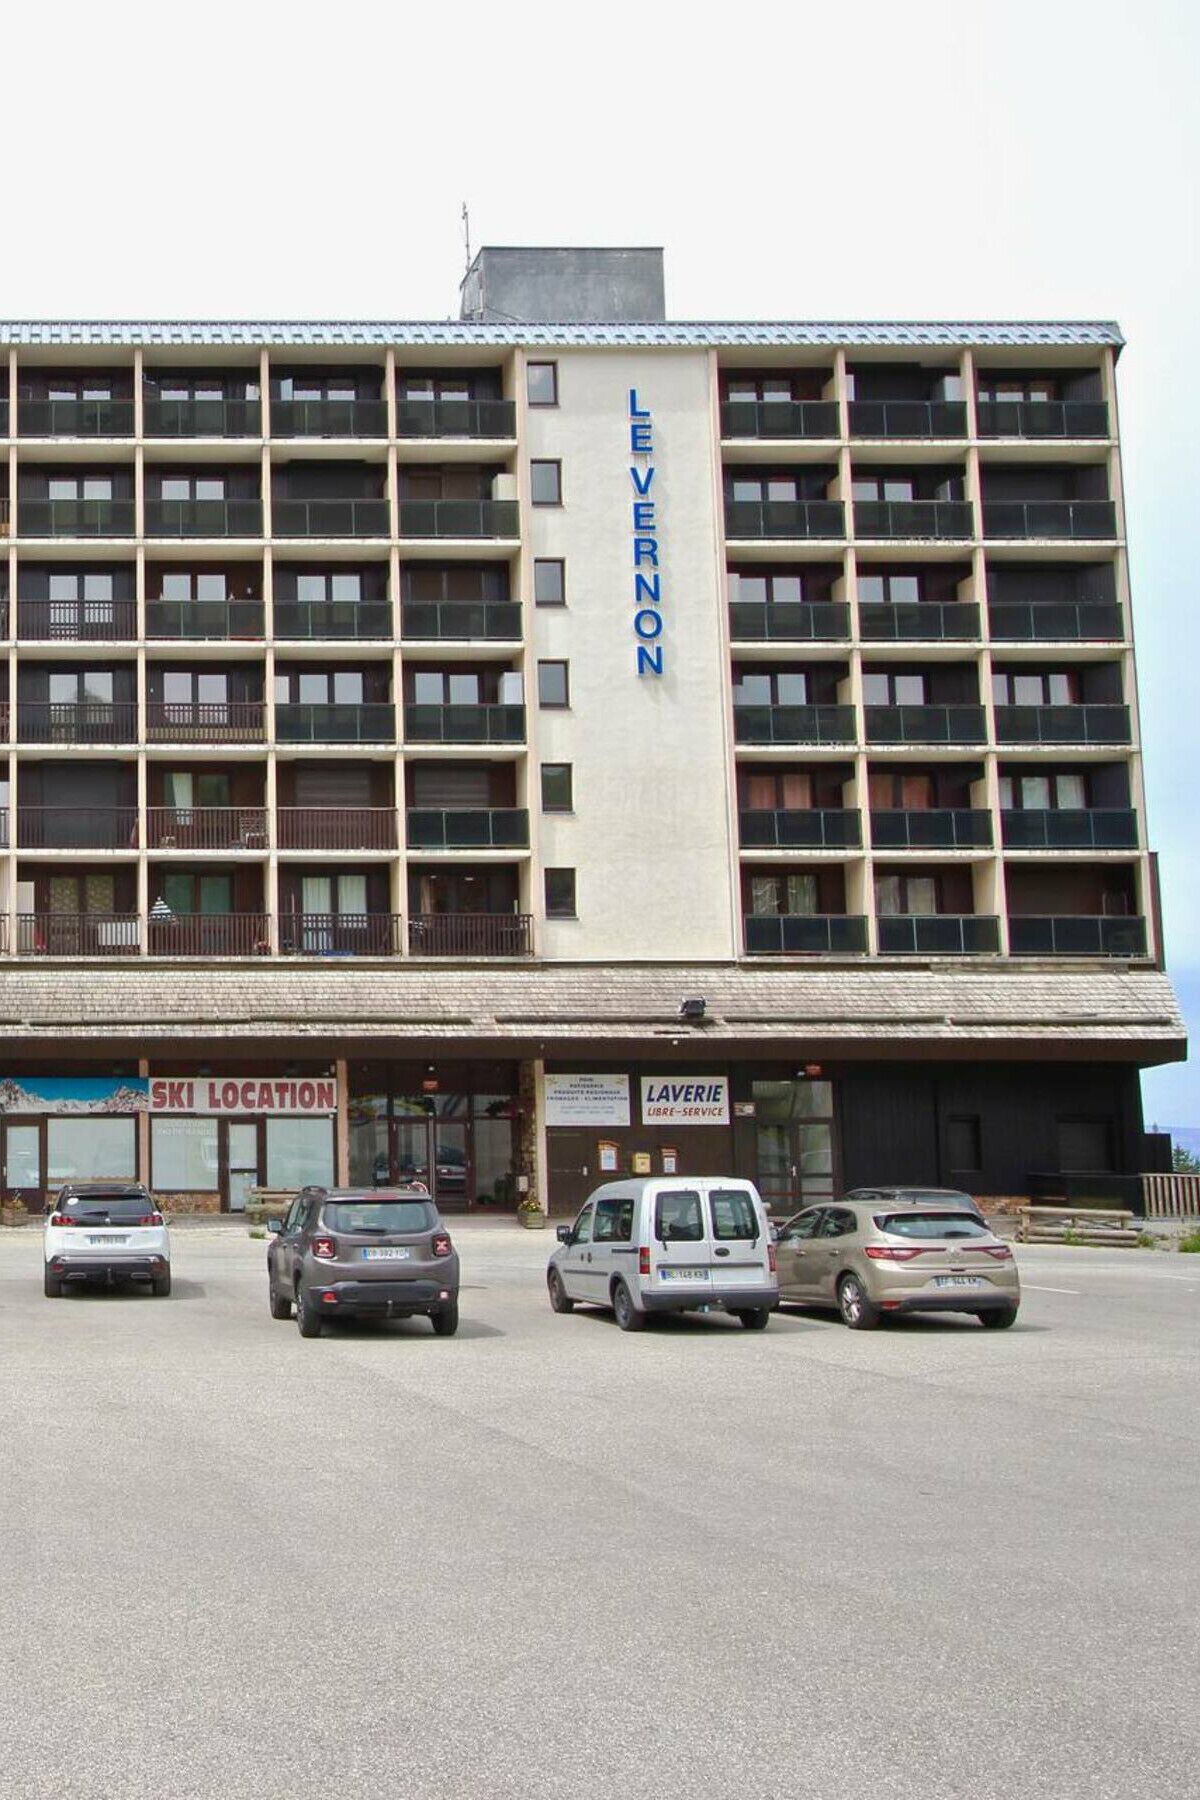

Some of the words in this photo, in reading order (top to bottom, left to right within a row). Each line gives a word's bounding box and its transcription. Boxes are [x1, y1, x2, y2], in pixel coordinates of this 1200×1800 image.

[629, 388, 653, 452] LE
[629, 466, 663, 675] VERNON
[152, 1081, 194, 1109] SKI
[208, 1082, 333, 1109] LOCATION
[646, 1084, 723, 1103] LAVERIE
[647, 1106, 724, 1117] LIBRE-SERVICE
